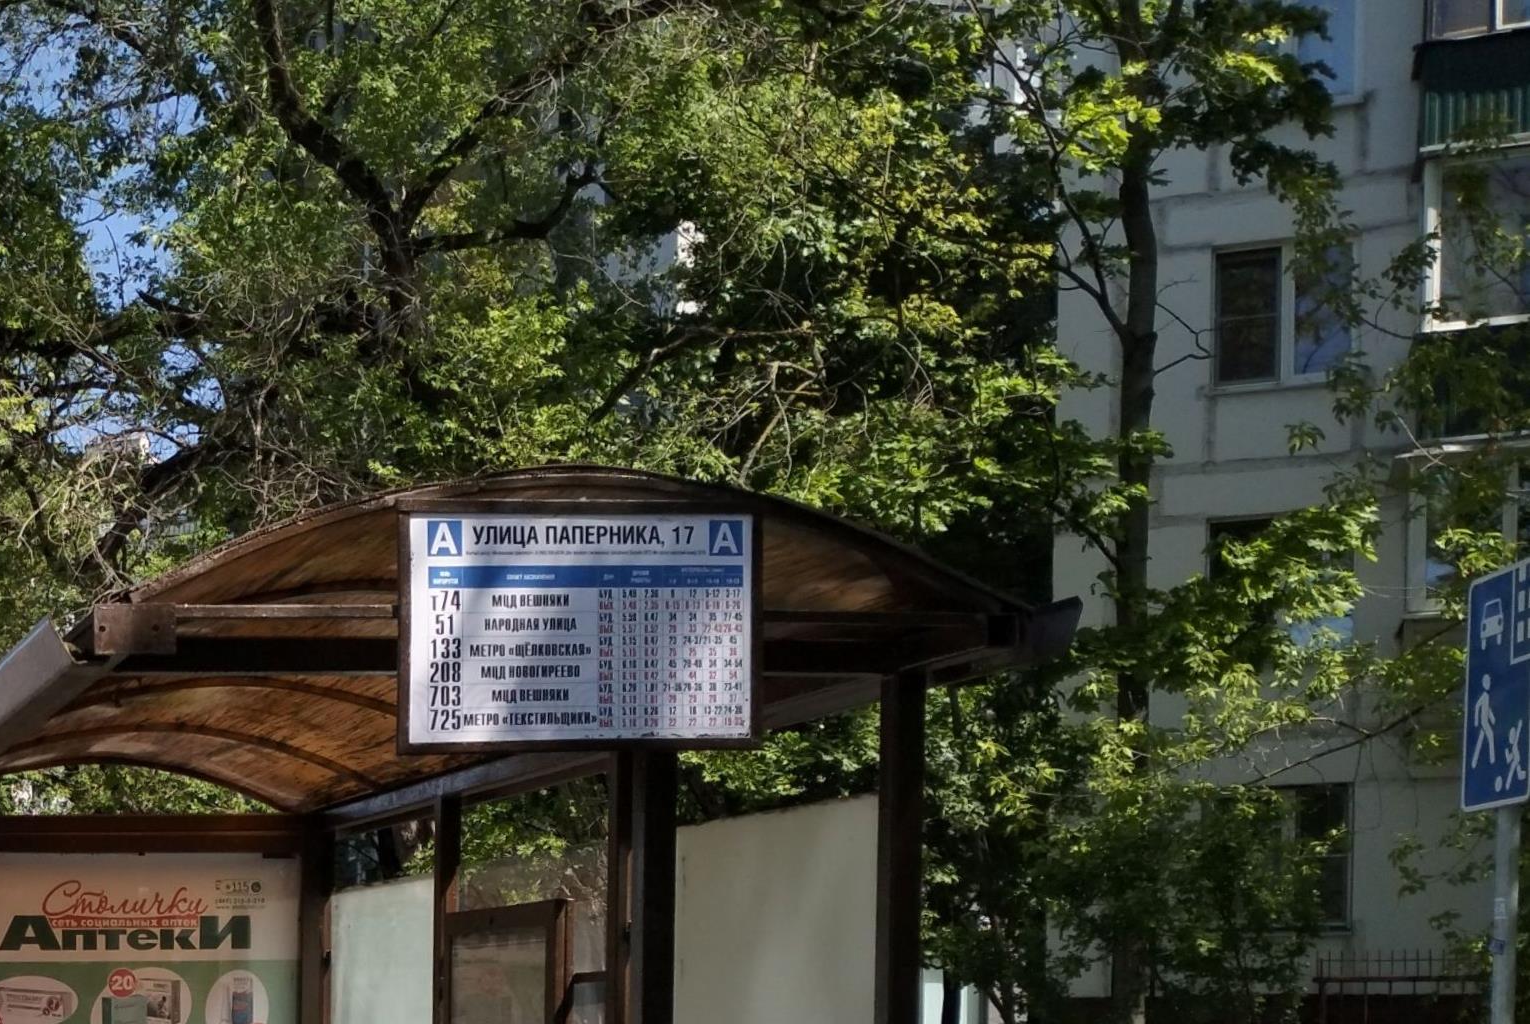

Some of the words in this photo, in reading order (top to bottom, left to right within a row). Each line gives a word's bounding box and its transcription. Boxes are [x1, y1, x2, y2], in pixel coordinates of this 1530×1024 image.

[430, 521, 459, 555] А
[472, 525, 539, 549] УЛИЦА
[545, 525, 666, 549] ПАПЕРНИКА,
[672, 525, 694, 545] 17
[712, 521, 739, 555] А
[491, 594, 518, 608] МЦД
[519, 593, 569, 607] ВЕШНЯКИ
[435, 614, 454, 635] 51
[484, 617, 540, 632] НАРОДНАЯ
[542, 617, 577, 632] УЛИЦА
[430, 638, 461, 659] 133
[469, 644, 506, 658] МЕТРО
[429, 661, 461, 683] 208
[481, 665, 506, 680] МЦД
[508, 664, 581, 679] НОВОГИРЕЕВО
[429, 685, 461, 707] 703
[491, 689, 518, 704] МЦД
[519, 688, 569, 702] ВЕШНЯКИ
[429, 709, 461, 731] 725
[463, 713, 500, 726] МЕТРО
[41, 879, 211, 916] Столички
[51, 919, 78, 928] сеть
[80, 919, 160, 929] социальных
[161, 919, 199, 928] аптек
